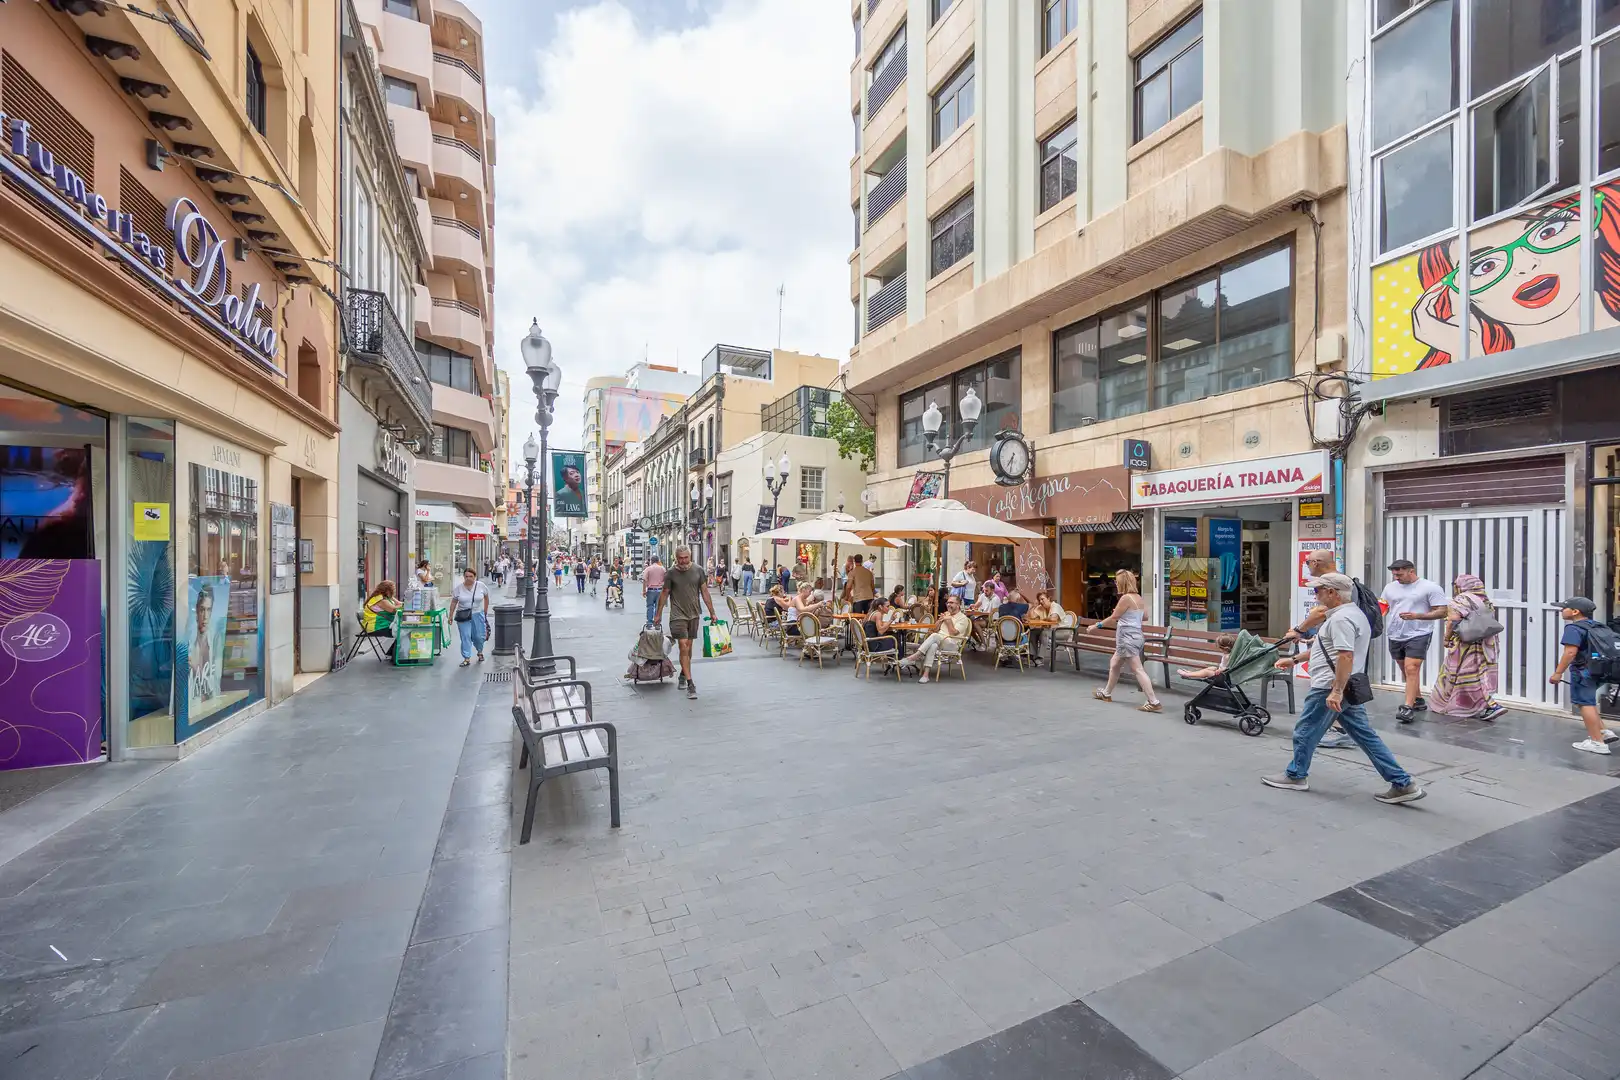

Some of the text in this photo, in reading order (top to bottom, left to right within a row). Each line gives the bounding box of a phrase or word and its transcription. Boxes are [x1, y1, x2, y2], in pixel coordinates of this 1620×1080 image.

[212, 444, 241, 469] ARMANI
[1130, 458, 1148, 468] IQOS
[1142, 467, 1305, 497] TABAQUERÍA TRIANA
[565, 503, 581, 512] LANG
[987, 489, 1019, 521] Café
